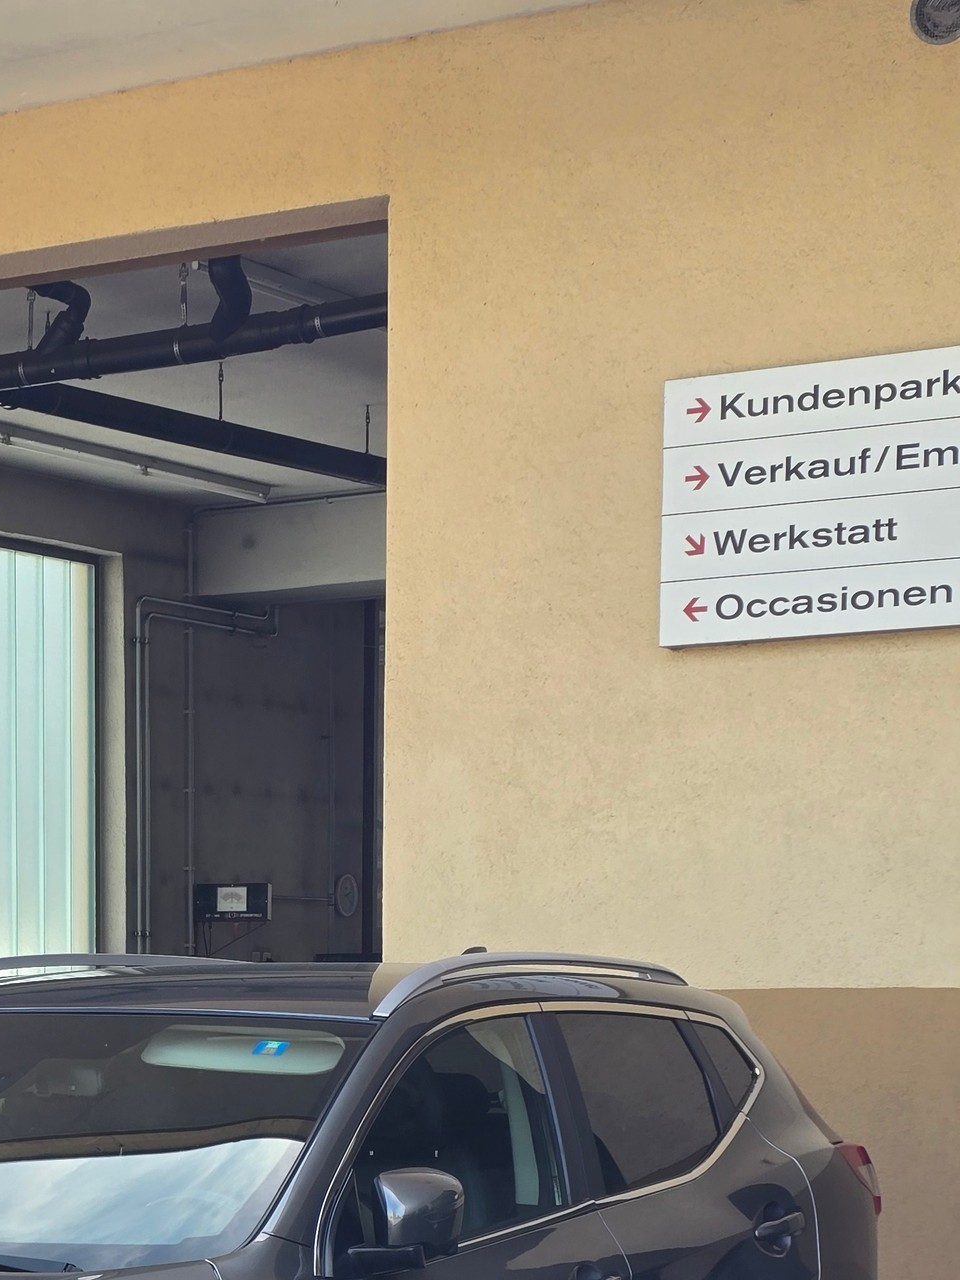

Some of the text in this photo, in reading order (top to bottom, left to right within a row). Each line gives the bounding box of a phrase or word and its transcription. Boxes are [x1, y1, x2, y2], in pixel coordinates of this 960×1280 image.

[720, 368, 960, 420] Kundenpark
[717, 443, 959, 488] Verkauf/Em
[713, 518, 898, 556] Werkstatt
[715, 583, 953, 620] Occasionen
